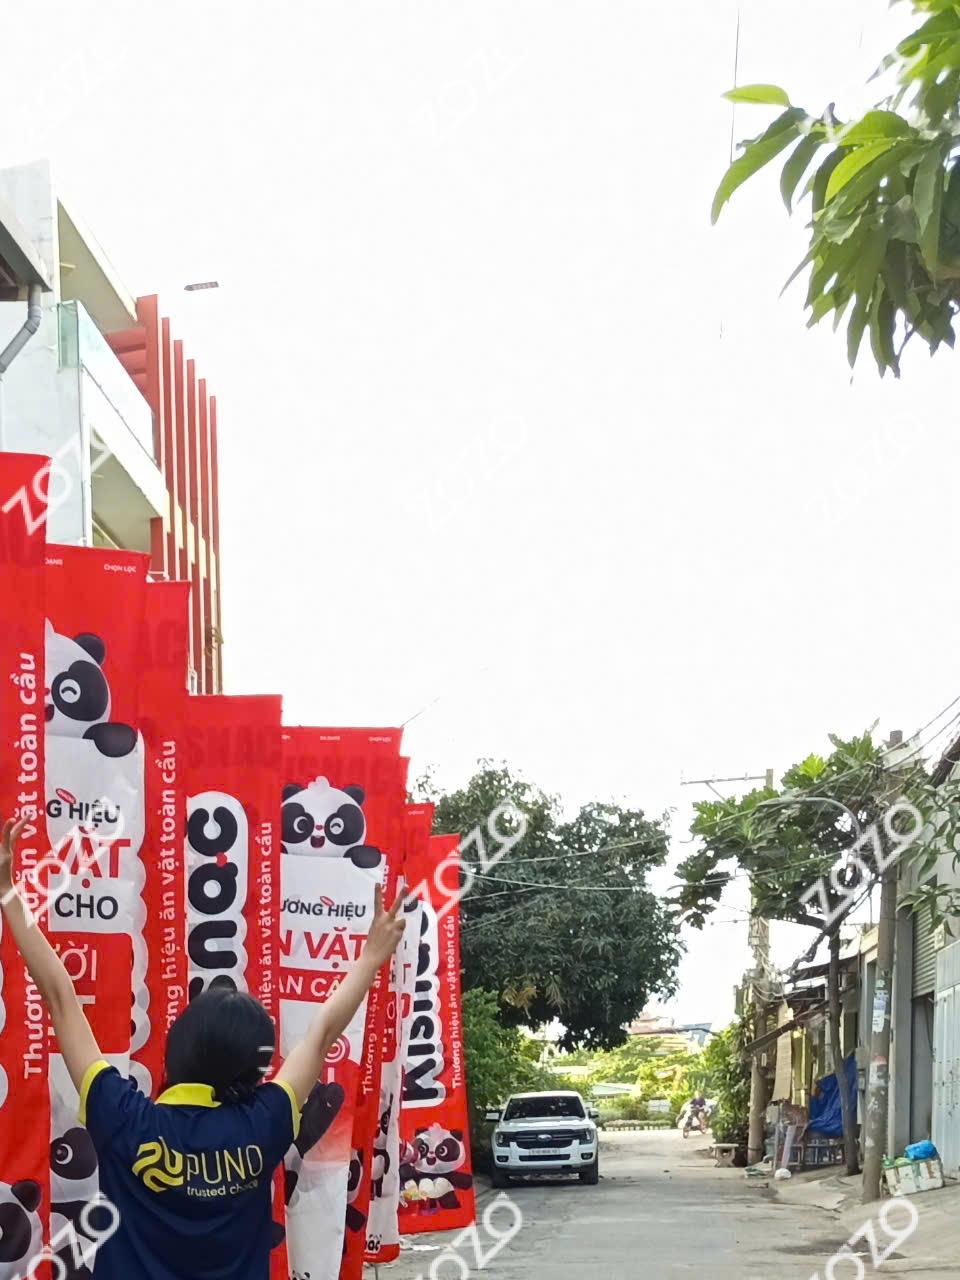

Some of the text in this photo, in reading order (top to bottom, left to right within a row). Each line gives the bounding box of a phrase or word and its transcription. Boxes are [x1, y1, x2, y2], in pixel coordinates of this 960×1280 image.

[10, 652, 37, 706] cầu
[13, 713, 38, 784] toàn
[155, 740, 176, 784] cầu
[157, 789, 176, 843] toàn
[257, 861, 272, 905] toàn
[54, 893, 119, 920] CHO
[159, 891, 176, 920] ăn
[327, 901, 366, 921] HIỆU
[161, 927, 181, 980] hiệu
[187, 1185, 226, 1198] trusted
